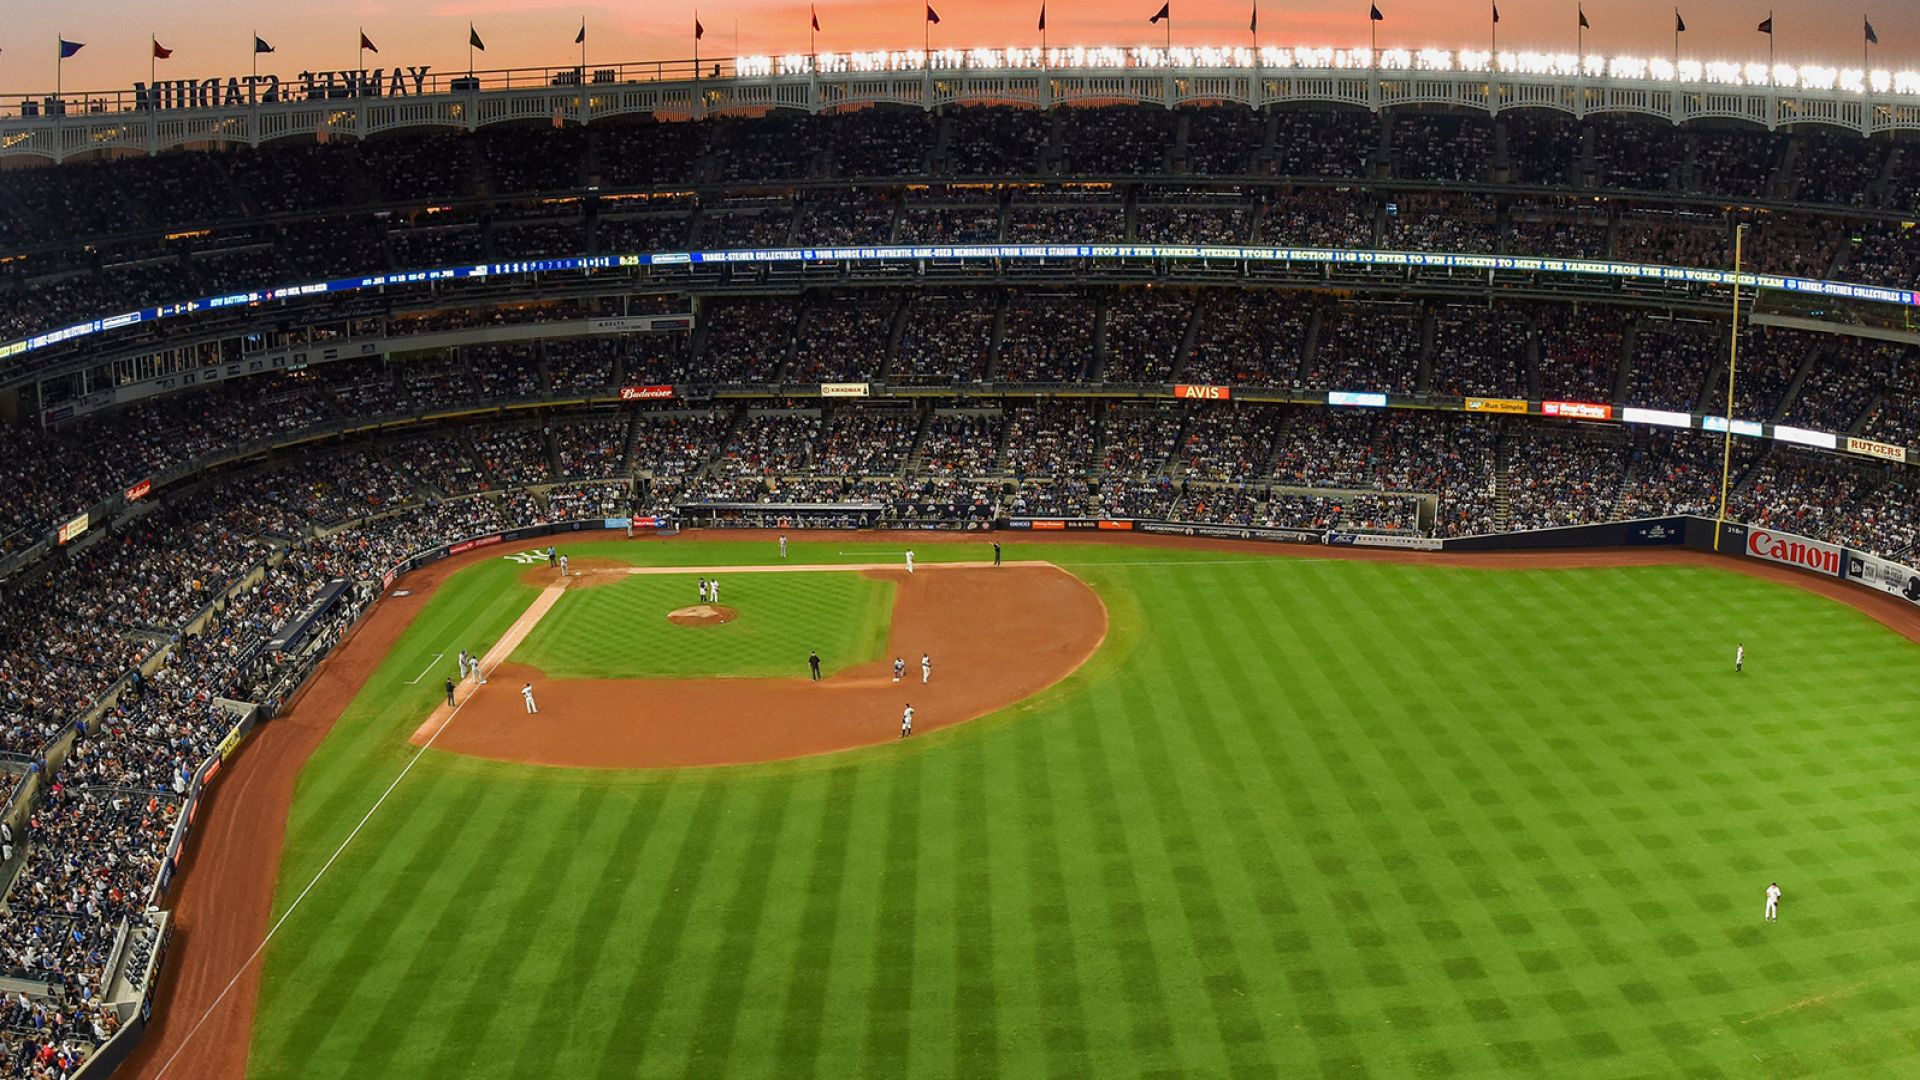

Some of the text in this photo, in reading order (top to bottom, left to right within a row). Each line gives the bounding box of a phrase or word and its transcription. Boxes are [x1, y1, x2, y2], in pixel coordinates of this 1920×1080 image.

[756, 252, 801, 260] COLLECTIBLES
[816, 250, 832, 258] YOUR
[834, 250, 860, 258] SOURCE
[862, 250, 875, 258] FOR
[1000, 248, 1020, 257] FROM
[1022, 248, 1046, 256] YANKEE
[1048, 248, 1077, 256] STADIUM
[620, 256, 639, 265] 8:25
[1092, 248, 1117, 256] STOP
[1119, 248, 1131, 256] BY
[1133, 248, 1152, 256] THE
[1242, 250, 1274, 259] STORE
[1276, 250, 1288, 259] AT
[1290, 251, 1333, 260] SECTION
[1359, 254, 1372, 262] TO
[1375, 254, 1407, 263] ENTER
[1409, 255, 1423, 263] TO
[1426, 256, 1446, 264] WIN
[1455, 257, 1496, 267] TICKETS
[1498, 259, 1512, 267] TO
[1514, 260, 1541, 269] MEET
[1545, 262, 1563, 270] THE
[1565, 263, 1608, 273] YANKEES
[1611, 265, 1640, 275] FROM
[1642, 267, 1660, 276] THE
[1685, 270, 1720, 281] WORLD
[1758, 277, 1784, 287] TEAM
[1854, 287, 1900, 301] COLLECTIBLES
[621, 388, 672, 399] Budweiser
[1186, 386, 1219, 398] AVIS
[1500, 404, 1524, 412] Simple
[1850, 440, 1902, 458] RUTGERS
[1749, 531, 1838, 572] Canon
